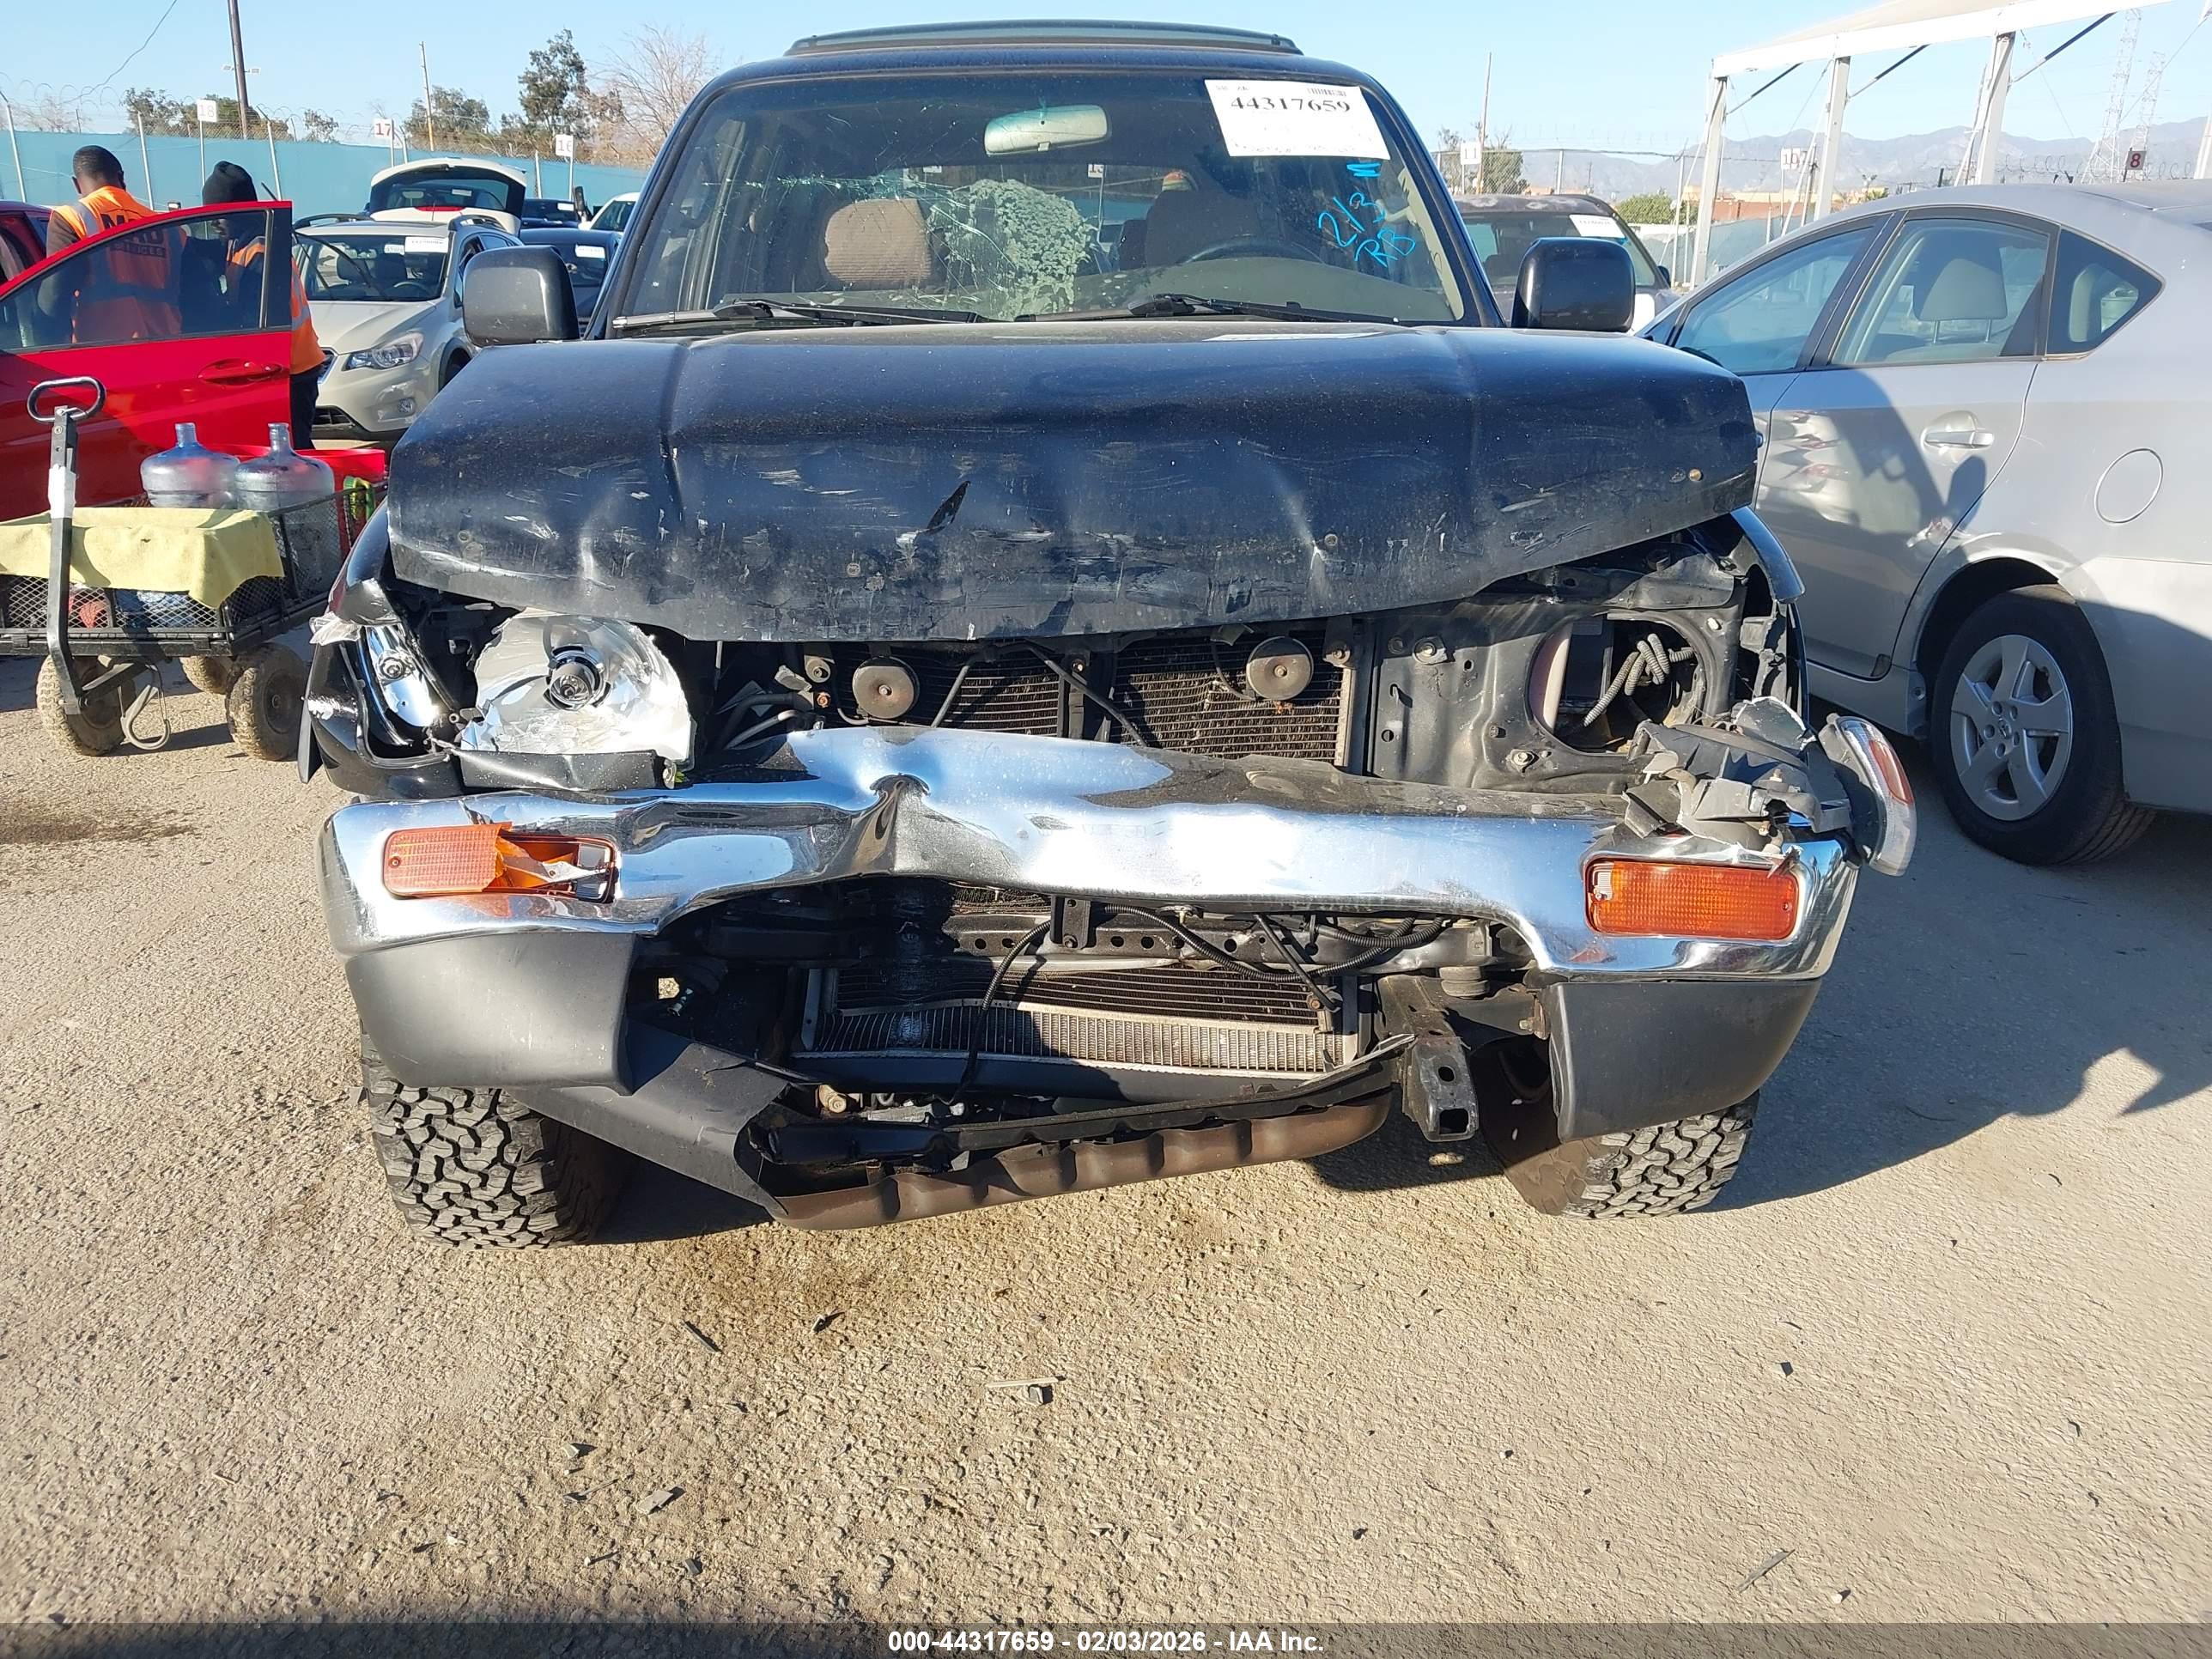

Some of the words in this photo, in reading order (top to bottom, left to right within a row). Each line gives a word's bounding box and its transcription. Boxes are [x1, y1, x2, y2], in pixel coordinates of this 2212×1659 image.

[198, 104, 215, 118] 18
[1231, 96, 1351, 113] 44317659
[375, 123, 391, 137] 17
[2130, 153, 2142, 168] 8
